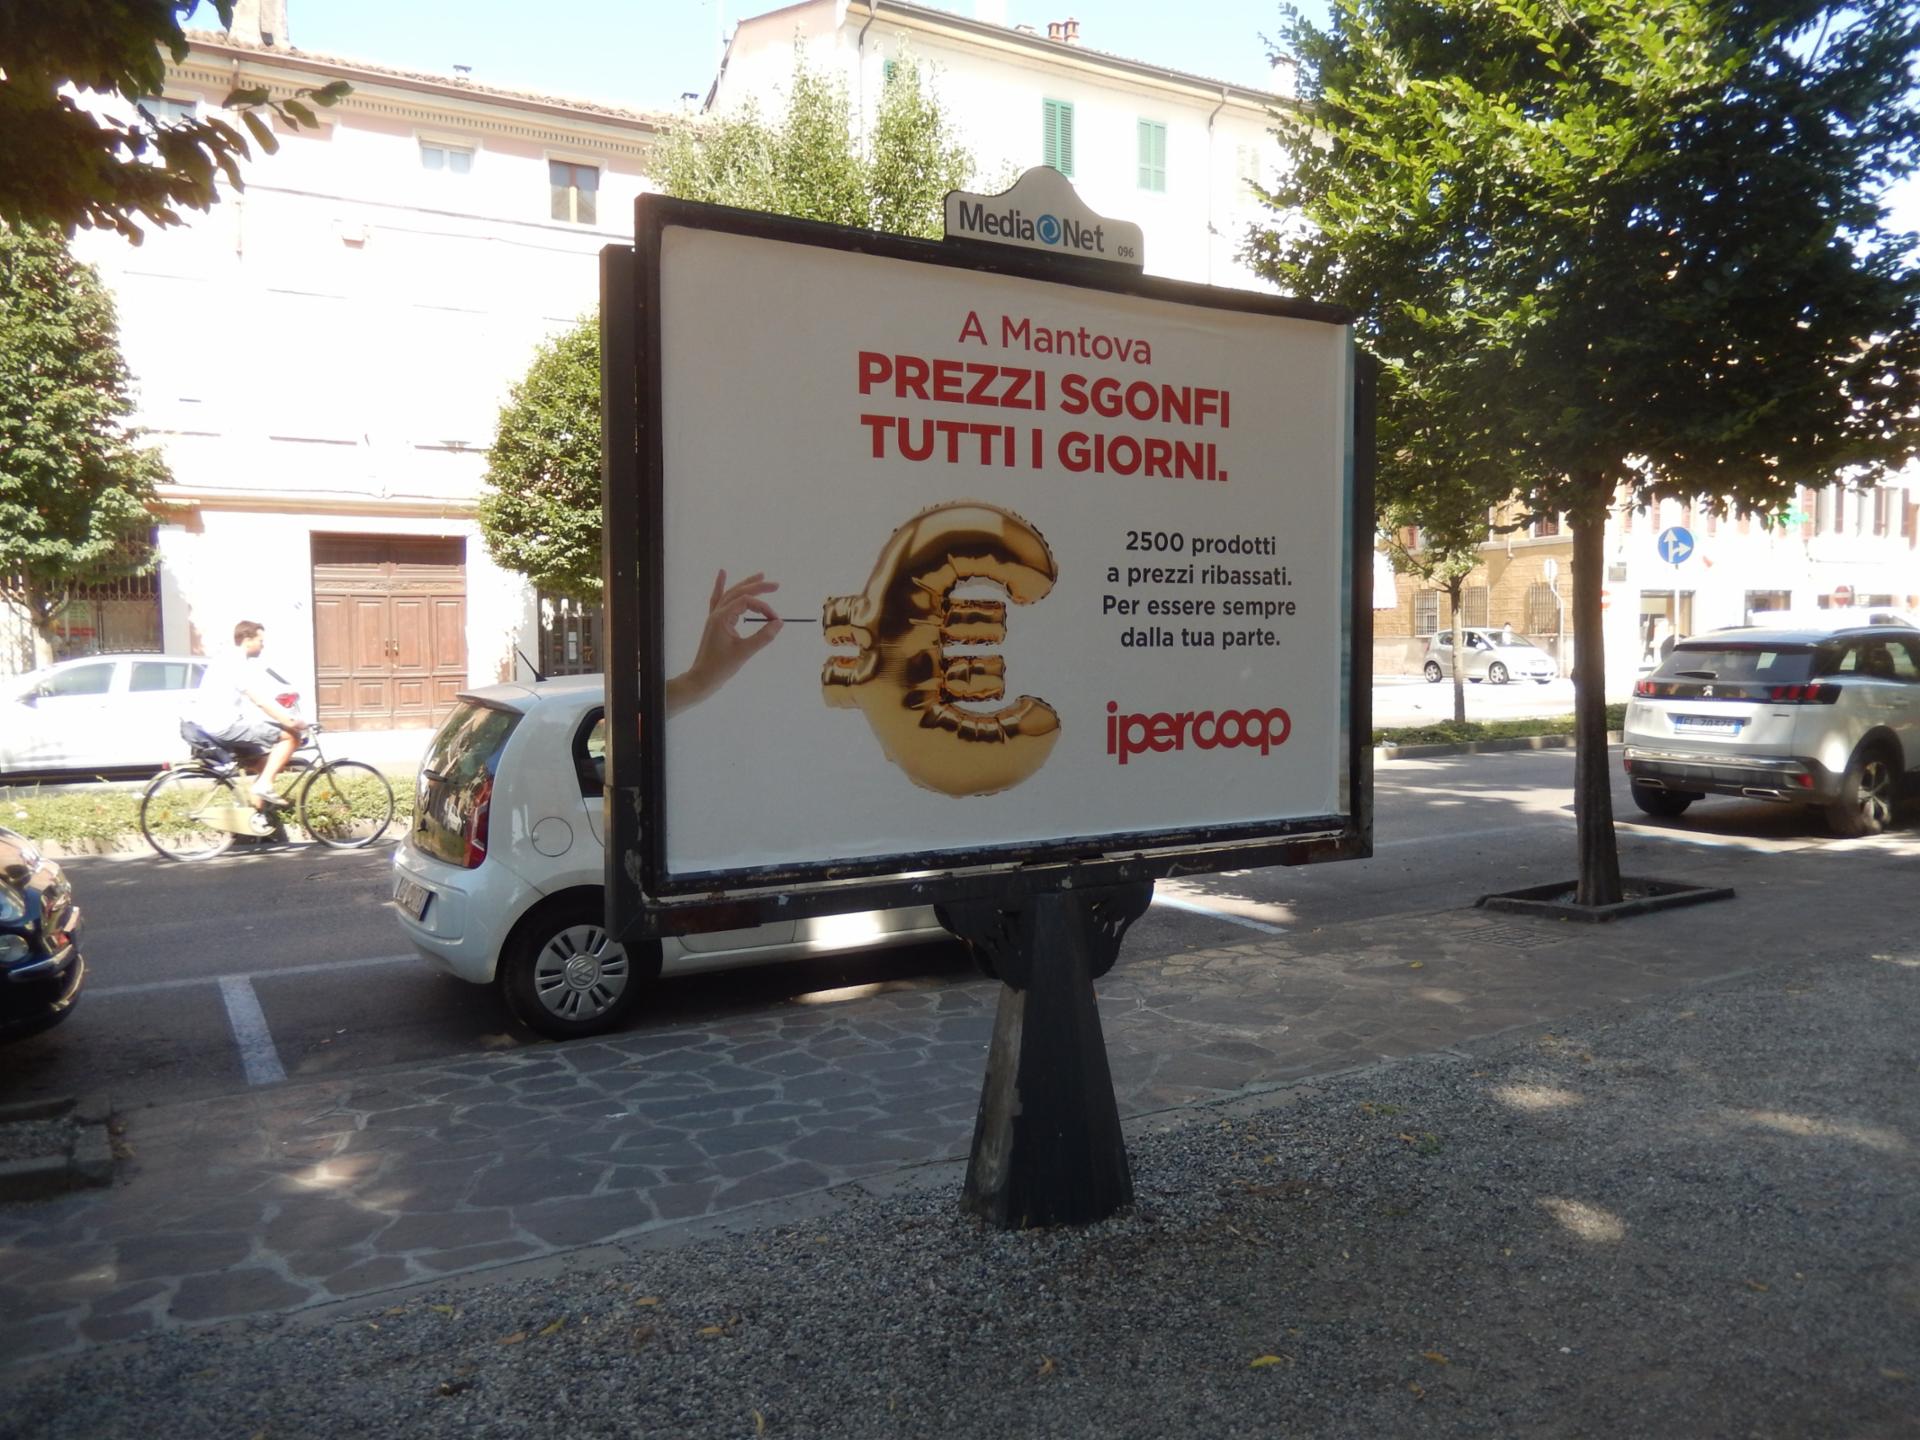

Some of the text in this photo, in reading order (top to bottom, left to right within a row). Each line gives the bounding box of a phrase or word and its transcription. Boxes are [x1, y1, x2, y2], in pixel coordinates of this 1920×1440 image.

[958, 200, 1105, 253] Media Net
[1117, 245, 1135, 259] 096
[957, 311, 1152, 364] A Mantova
[859, 351, 1230, 428] PREZZI SGONFI
[860, 414, 1228, 481] TUTTI I GIORNI.
[1125, 530, 1276, 556] 2500 prodotti
[1106, 563, 1293, 587] a prezzi ribassati.
[1103, 594, 1297, 620] Per essere sempre
[1120, 626, 1281, 650] dalla tua parte.
[1107, 702, 1291, 764] ipercoop
